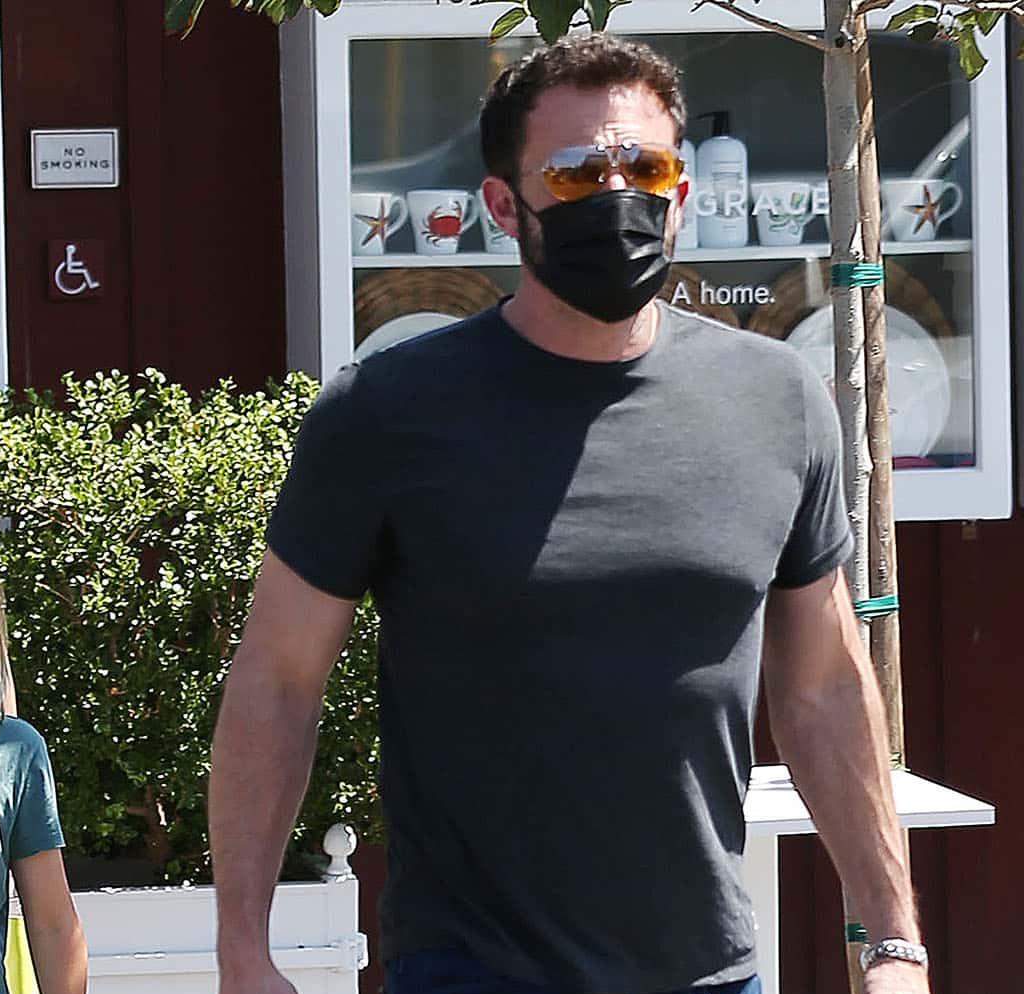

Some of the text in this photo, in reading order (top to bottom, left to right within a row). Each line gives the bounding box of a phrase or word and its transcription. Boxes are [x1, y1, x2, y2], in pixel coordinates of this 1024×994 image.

[63, 147, 86, 157] NO
[39, 159, 110, 170] SMOKING
[670, 279, 777, 304] A home.
